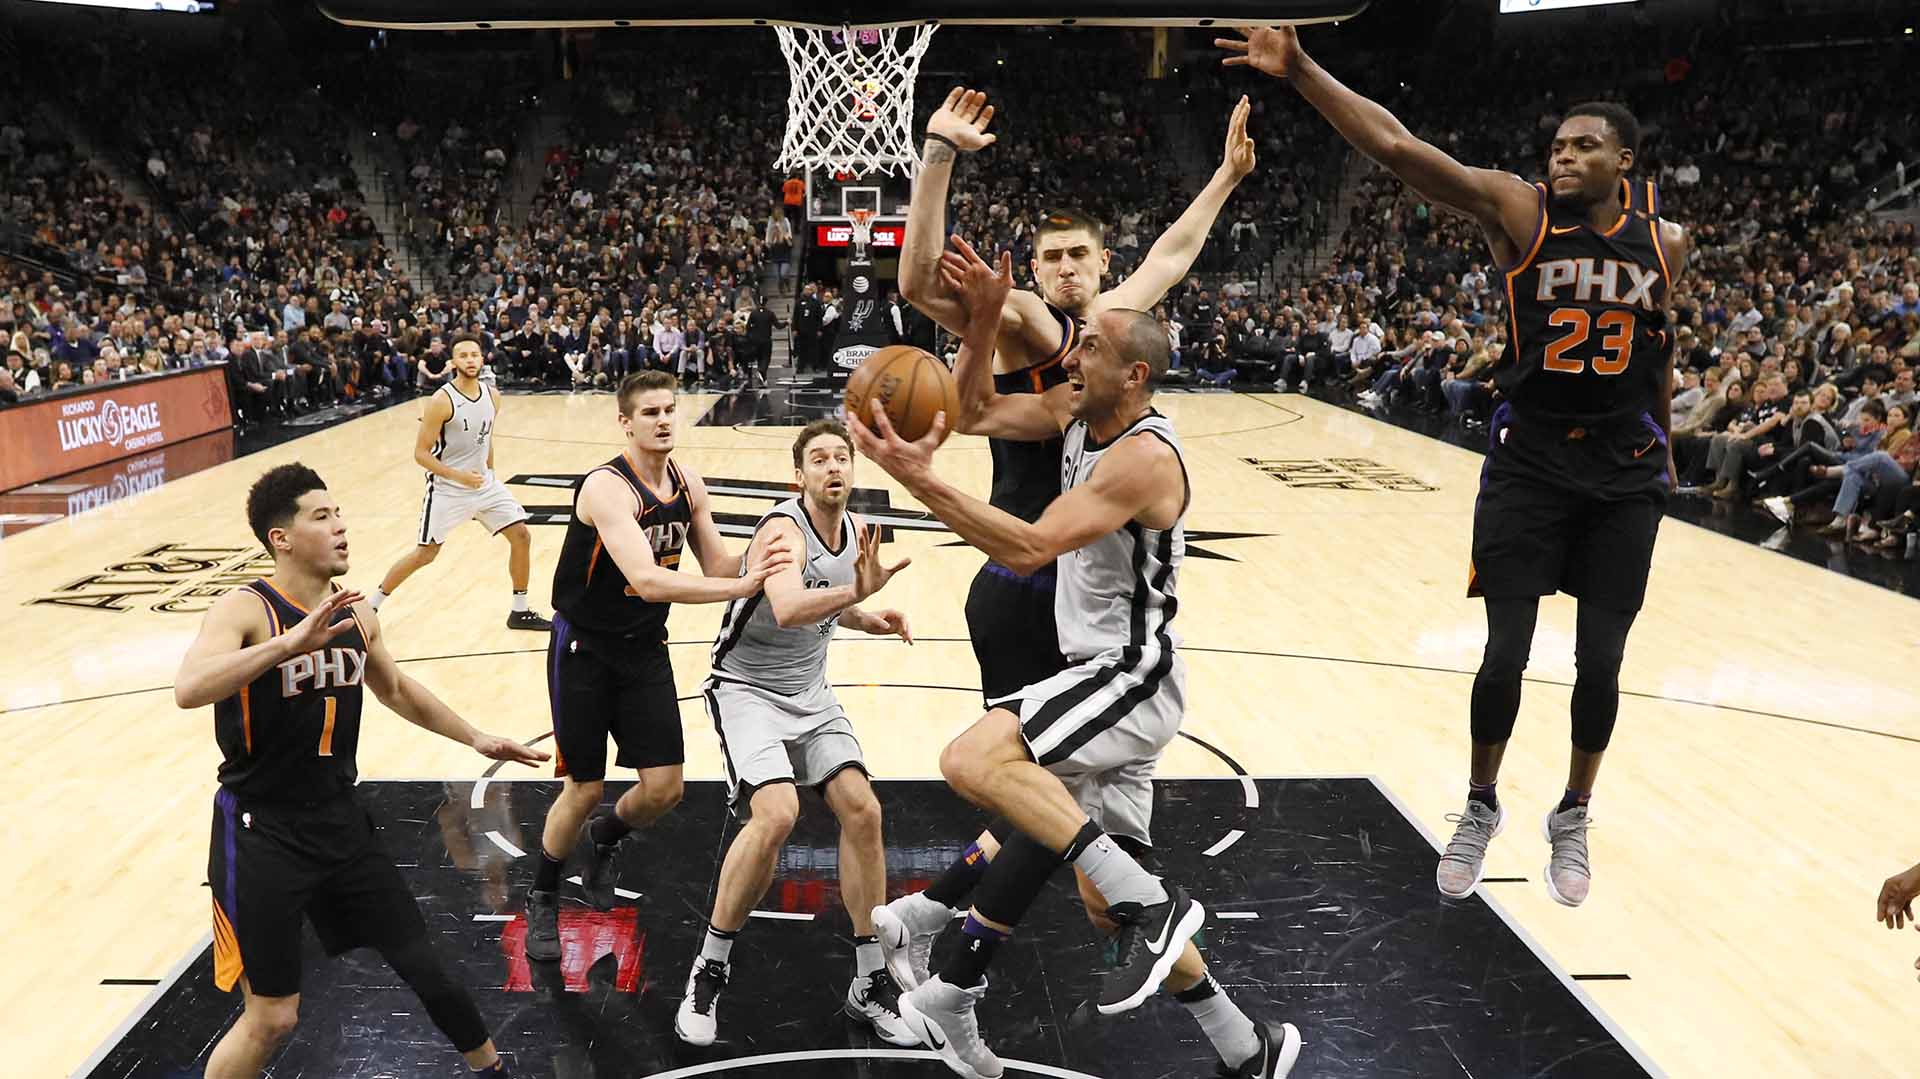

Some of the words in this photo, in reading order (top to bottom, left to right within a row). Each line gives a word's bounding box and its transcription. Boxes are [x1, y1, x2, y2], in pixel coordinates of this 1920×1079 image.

[1536, 257, 1660, 311] PHX
[1543, 307, 1636, 375] 23
[57, 415, 104, 451] LUCKY
[120, 402, 161, 436] EAGLE
[462, 418, 469, 431] 1
[276, 647, 368, 698] PHX
[318, 696, 338, 756] 1
